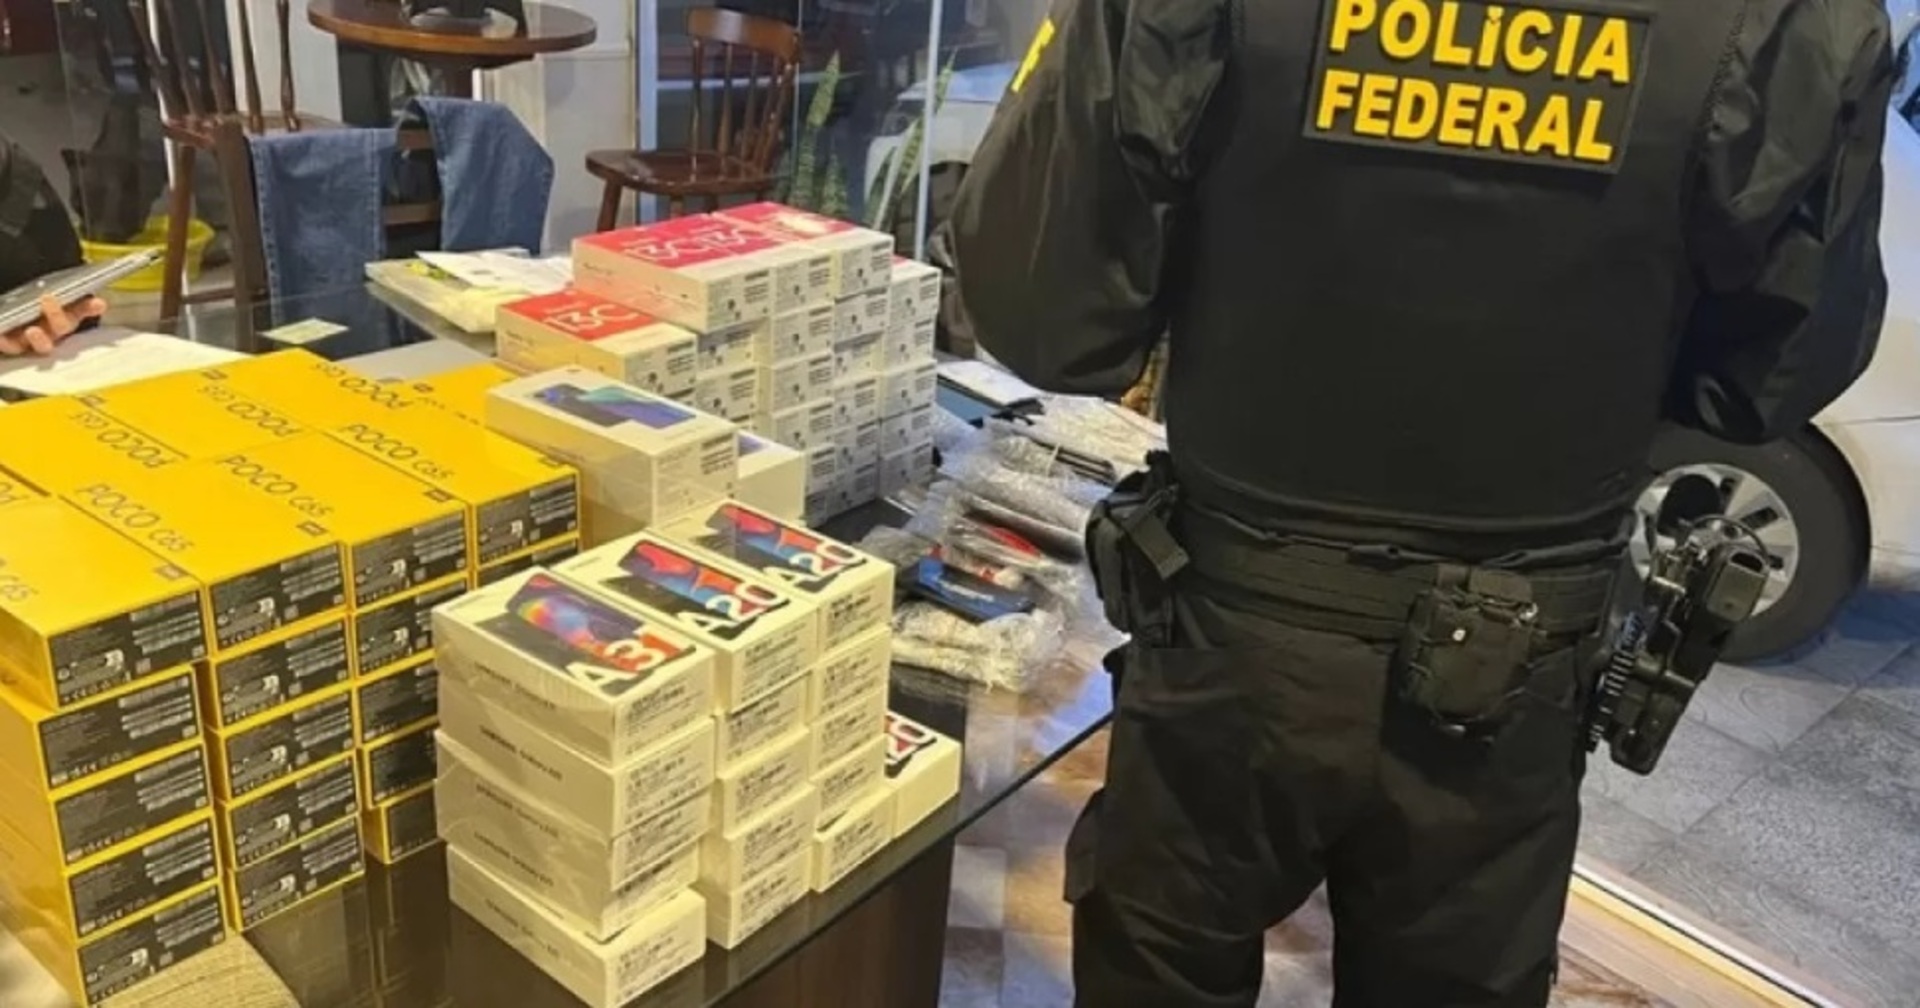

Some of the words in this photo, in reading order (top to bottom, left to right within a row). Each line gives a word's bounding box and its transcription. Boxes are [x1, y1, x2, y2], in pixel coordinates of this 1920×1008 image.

[1316, 69, 1613, 161] FEDERAL
[543, 303, 640, 333] 13C
[226, 401, 304, 437] POCO
[339, 424, 419, 460] POCO
[96, 429, 178, 469] POCO
[216, 454, 299, 495] POCO
[74, 483, 162, 529] POCO
[762, 544, 863, 590] A20
[677, 583, 786, 635] A20
[564, 621, 692, 692] A31
[884, 718, 936, 768] 20
